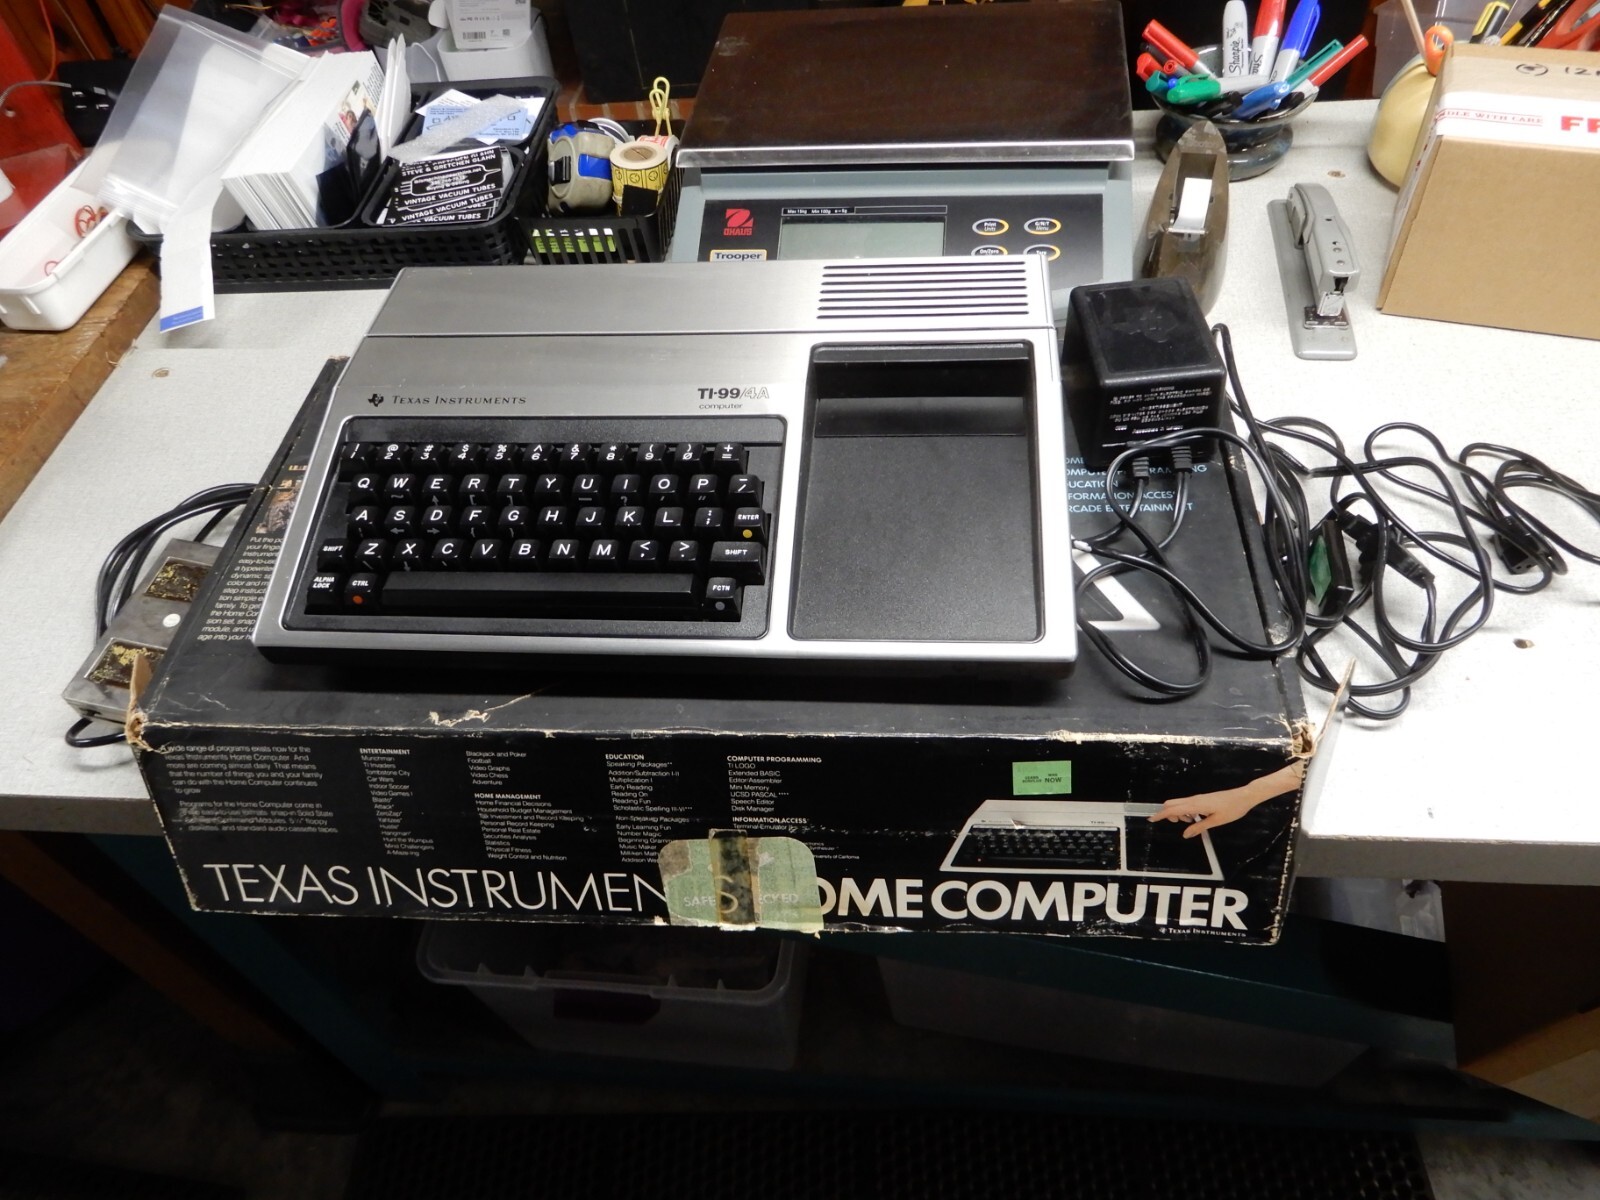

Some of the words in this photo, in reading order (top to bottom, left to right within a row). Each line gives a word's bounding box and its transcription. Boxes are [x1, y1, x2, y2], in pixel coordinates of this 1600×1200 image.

[1229, 40, 1240, 73] Sharpie
[1475, 112, 1508, 121] WITH
[434, 160, 470, 170] GRETCHEN
[404, 195, 436, 205] VINTAGE
[439, 188, 470, 199] VACUUM
[473, 184, 496, 192] TUBES
[402, 209, 434, 221] VINTAGE
[437, 200, 467, 212] VACUUM
[470, 193, 494, 203] TUBES
[698, 387, 769, 399] TI-99/4A
[392, 396, 430, 404] TEXAS
[435, 396, 526, 404] INSTRUMENTS
[358, 478, 370, 489] Q
[393, 478, 409, 488] W
[431, 478, 443, 488] E
[468, 478, 481, 488] R
[508, 478, 519, 489] T
[546, 478, 557, 489] Y
[581, 478, 594, 489] U
[658, 479, 670, 489] O
[698, 478, 709, 490] P
[356, 510, 368, 521] A
[394, 510, 406, 520] S
[430, 510, 443, 521] D
[469, 510, 482, 521] F
[508, 511, 520, 521] G
[545, 510, 560, 522] H
[585, 511, 596, 522] J
[624, 511, 636, 522] K
[663, 512, 674, 522] L
[364, 543, 379, 554] Z
[402, 543, 416, 554] X
[441, 544, 453, 554] C
[481, 544, 493, 555] V
[519, 544, 531, 555] B
[558, 544, 570, 555] N
[596, 544, 612, 556] M
[203, 864, 358, 906] TEXAS
[930, 879, 1249, 930] COMPUTER
[1193, 928, 1246, 937] INSTRUMENTS
